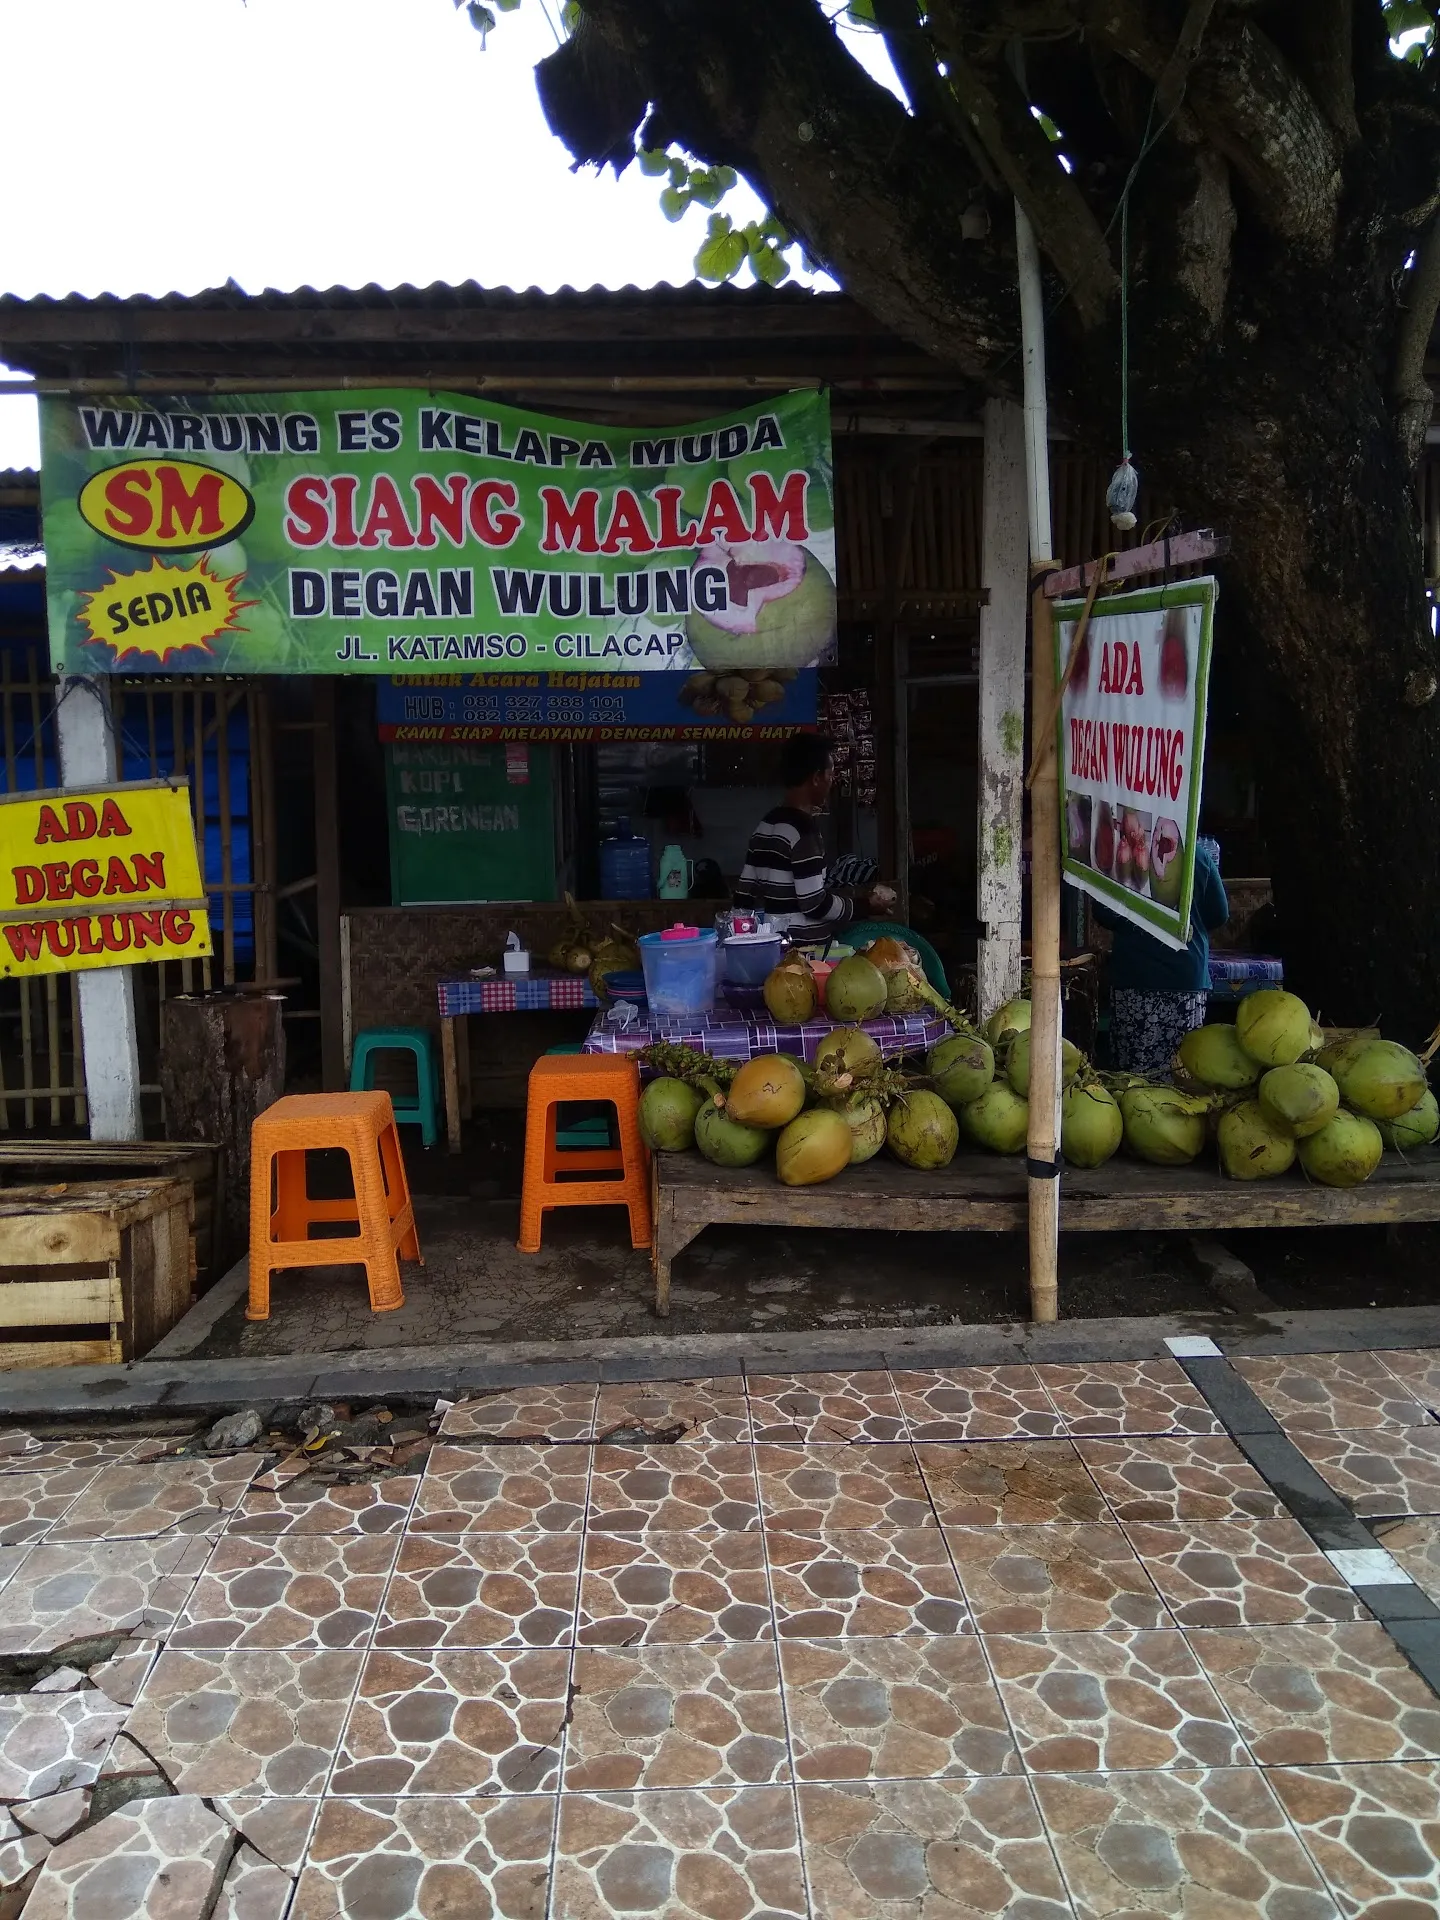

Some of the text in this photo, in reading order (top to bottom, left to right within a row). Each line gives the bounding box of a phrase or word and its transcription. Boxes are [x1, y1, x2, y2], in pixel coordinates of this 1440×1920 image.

[79, 406, 787, 468] WARUNG ES KELAPA MUDA
[104, 466, 225, 540] SM
[284, 470, 811, 555] SIANG MALAM
[106, 581, 212, 635] SEDIA
[288, 564, 730, 620] DEGAN WULUNG
[336, 636, 379, 661] JL.
[388, 632, 527, 661] KATAMSO
[553, 633, 685, 658] CILACAP
[1098, 640, 1144, 695] ADA
[463, 696, 497, 708] 081
[505, 696, 541, 708] 327
[590, 696, 624, 708] 101
[469, 671, 540, 688] Acara
[547, 671, 641, 692] Hajatan
[395, 726, 445, 739] KAMI
[451, 726, 494, 739] SIAP
[499, 726, 594, 740] MELAYANI
[600, 726, 675, 740] DENGAN
[681, 727, 753, 740] SENANG
[463, 710, 626, 722] 082 324 900 324
[1070, 718, 1183, 801] DEGAN WULUNG
[34, 798, 132, 844] ADA
[397, 804, 519, 834] GORENGAN
[12, 852, 166, 904] DEGAN
[3, 910, 195, 962] WULUNG
